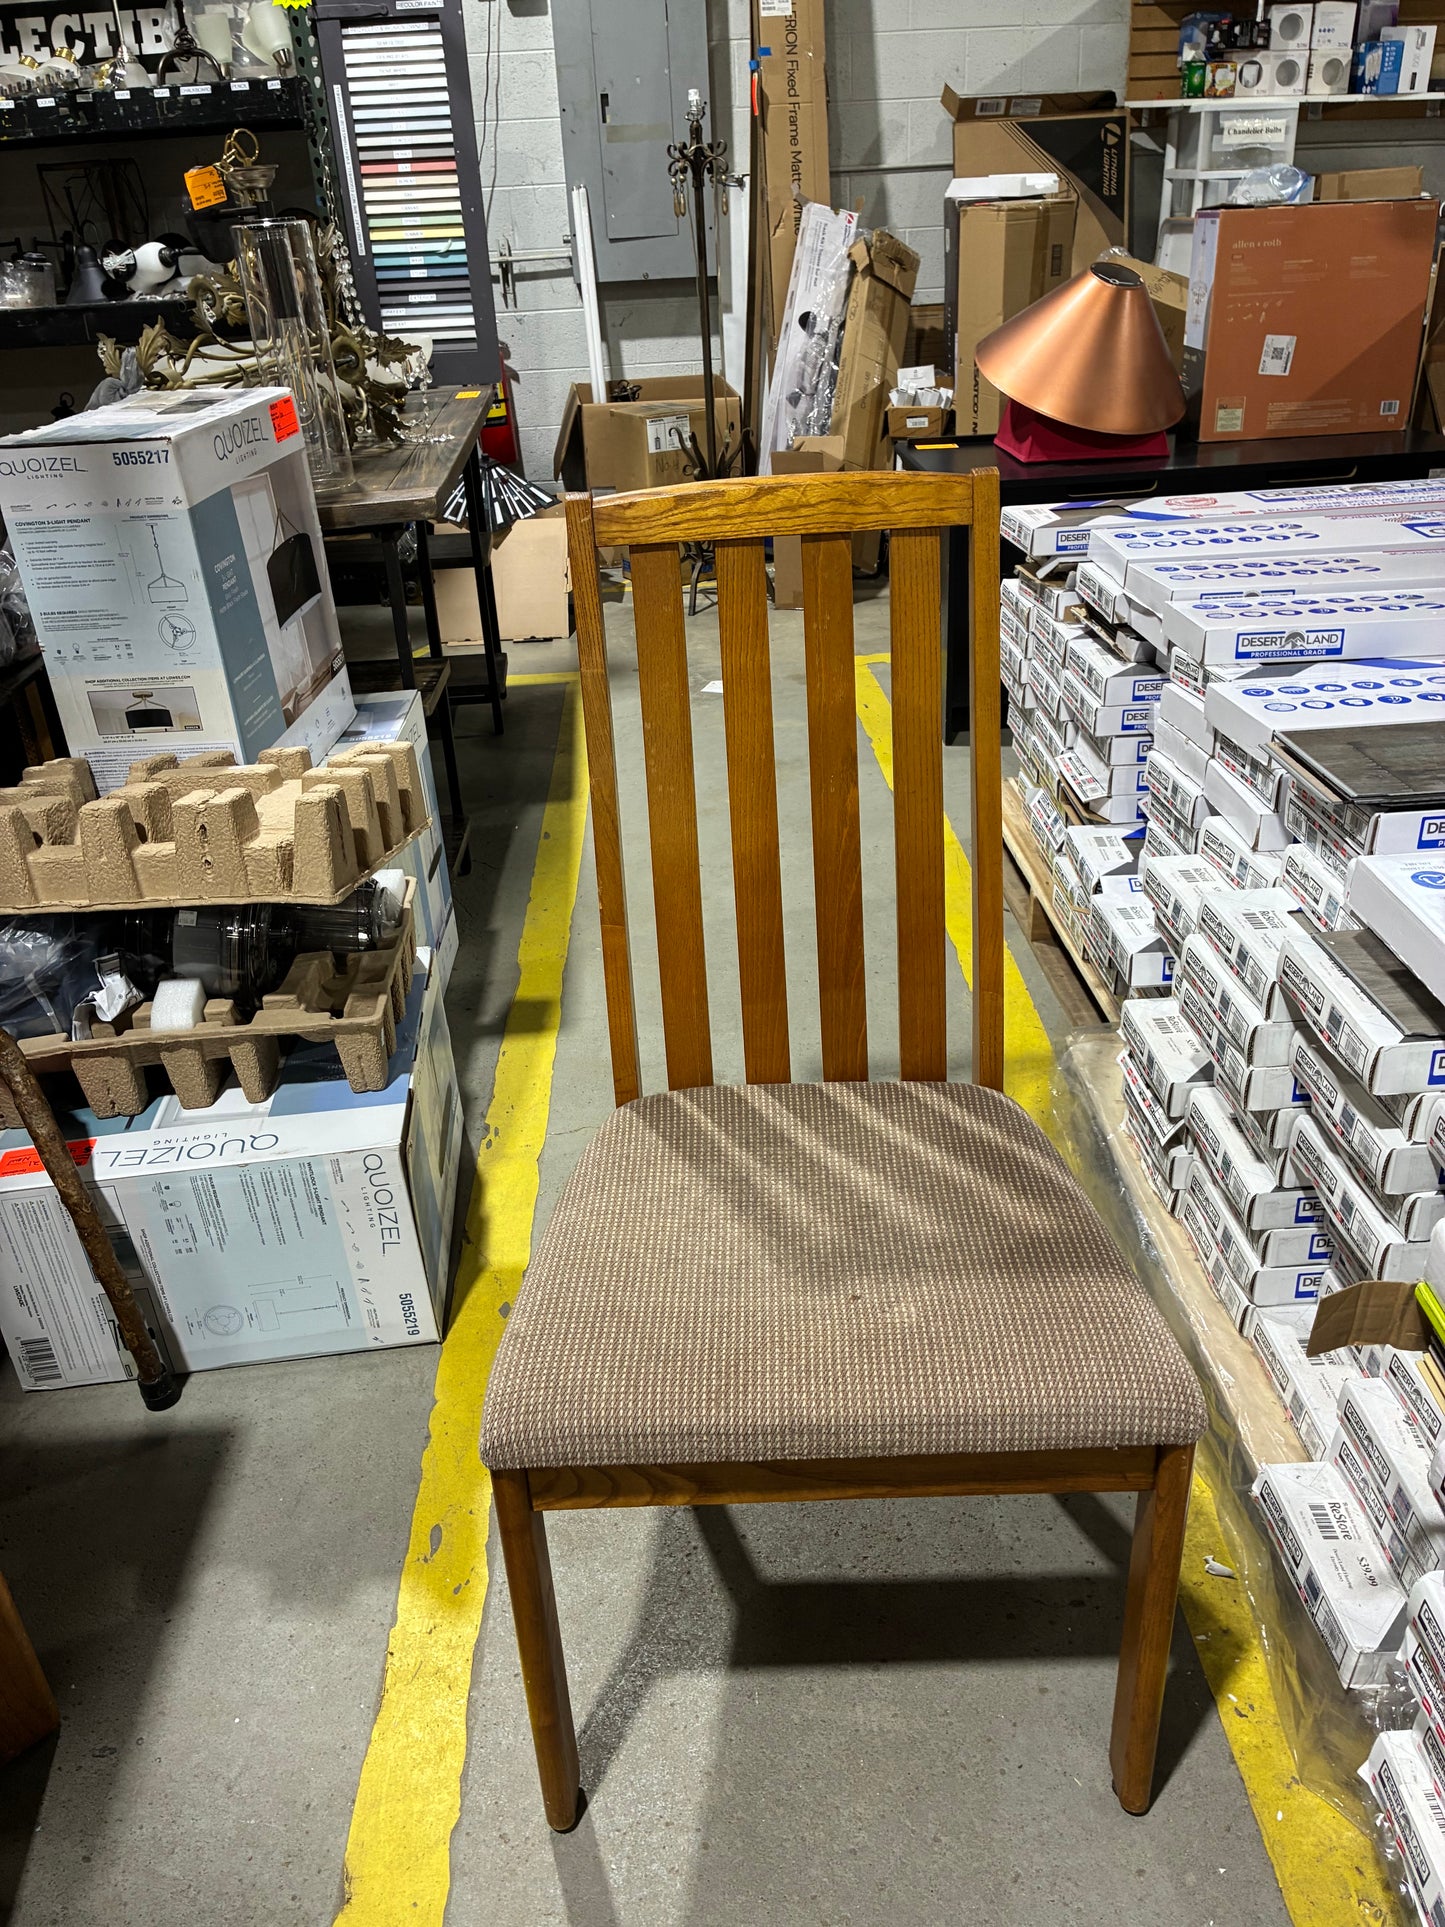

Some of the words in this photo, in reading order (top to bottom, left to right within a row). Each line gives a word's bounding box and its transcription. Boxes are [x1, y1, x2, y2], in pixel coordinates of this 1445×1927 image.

[786, 59, 799, 98] Fixed
[788, 102, 801, 147] Frame
[1227, 126, 1264, 136] Chandelier
[1265, 126, 1282, 135] Bulbs
[1110, 148, 1118, 196] LITHONIA
[1232, 240, 1255, 249] allen
[1263, 239, 1282, 248] roth
[112, 450, 169, 466] 5055217
[214, 418, 268, 460] QUOIZEL
[0, 457, 88, 476] QUOIZEL
[213, 553, 236, 574] COVINGTON
[1241, 637, 1285, 649] DESERT
[1306, 633, 1339, 645] LAND
[1250, 651, 1301, 659] PROFESSIONAL
[1303, 649, 1327, 657] GRADE
[1285, 959, 1303, 981] DESERT
[1308, 987, 1323, 1009] LAND
[1298, 1052, 1316, 1074] DESERT
[1322, 1079, 1337, 1100] LAND
[101, 1134, 279, 1168] QUOIZEL
[153, 1131, 228, 1146] LIGHTING
[1298, 1134, 1316, 1159] DESERT
[1322, 1165, 1336, 1186] LAND
[306, 1161, 318, 1187] WHITLOCK
[317, 1204, 327, 1226] PENDANT
[360, 1186, 376, 1229] LIGHTING
[363, 1153, 401, 1255] QUOIZEL
[144, 1238, 155, 1262] ADDITIONAL
[151, 1261, 163, 1286] COLLECTION
[399, 1293, 421, 1336] 5055219
[1392, 1358, 1415, 1392] DESERT
[1420, 1399, 1438, 1429] LAND
[1346, 1405, 1368, 1438] DESERT
[1374, 1447, 1390, 1477] LAND
[1342, 1449, 1363, 1481] DESERT
[1369, 1493, 1385, 1519] LAND
[1264, 1486, 1283, 1519] DESERT
[1285, 1528, 1302, 1562] LAND
[1328, 1502, 1352, 1540] ReStore
[1357, 1556, 1379, 1587] $39.99
[1418, 1652, 1443, 1699] DESERT
[1382, 1767, 1405, 1813] DESERT
[1410, 1830, 1429, 1875] LAND
